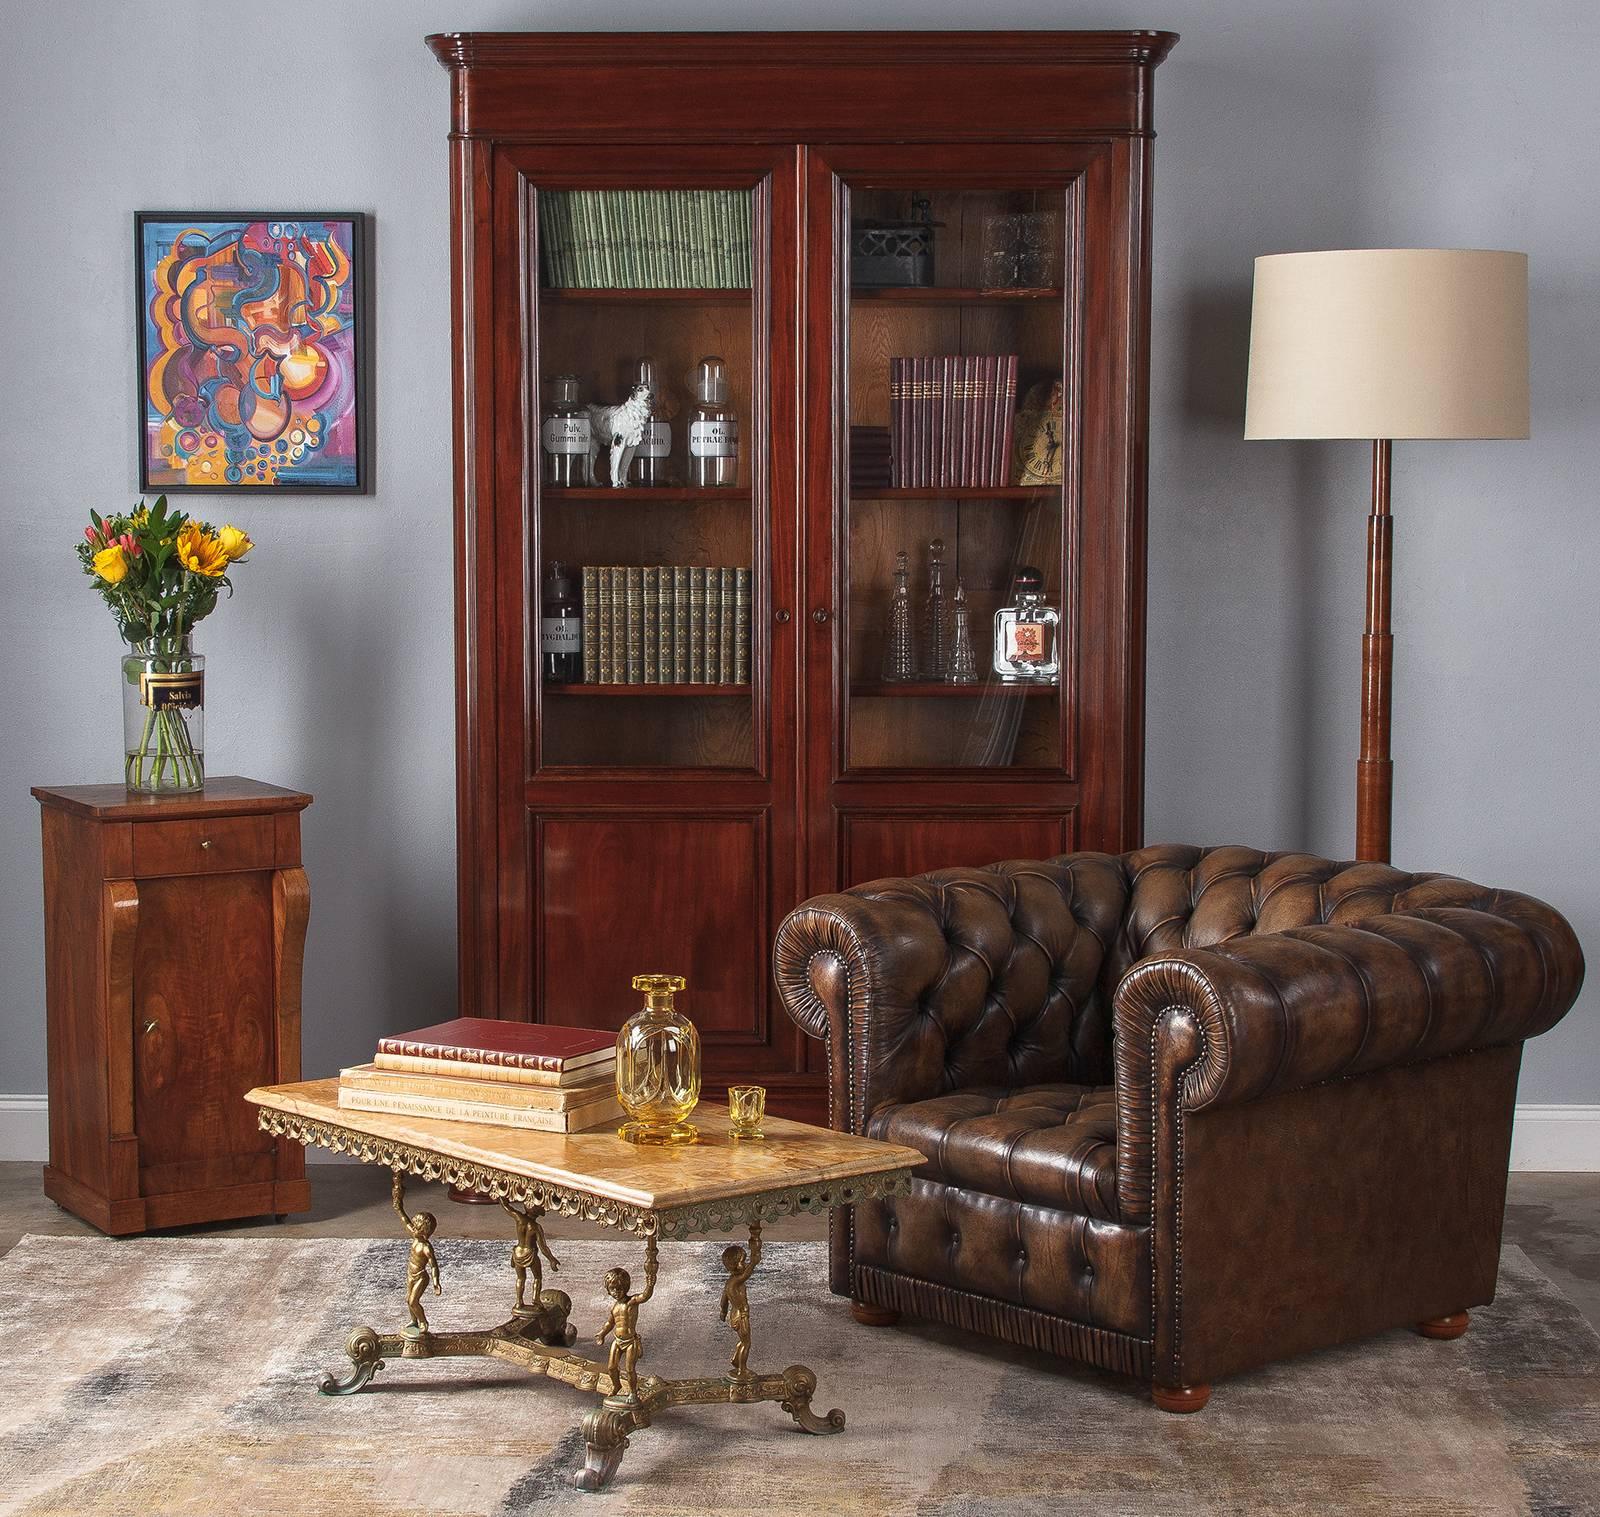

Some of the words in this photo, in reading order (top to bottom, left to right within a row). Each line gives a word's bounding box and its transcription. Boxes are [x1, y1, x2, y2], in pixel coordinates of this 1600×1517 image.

[563, 423, 581, 433] Pulv.
[550, 433, 576, 443] Gummi
[169, 690, 192, 700] Salvia
[351, 1096, 371, 1106] POUR
[392, 1100, 442, 1114] RENAISSANCE
[445, 1106, 456, 1115] DE
[459, 1107, 471, 1117] LA
[472, 1109, 510, 1121] PEINTURE
[513, 1113, 553, 1125] FRANÇAISE
